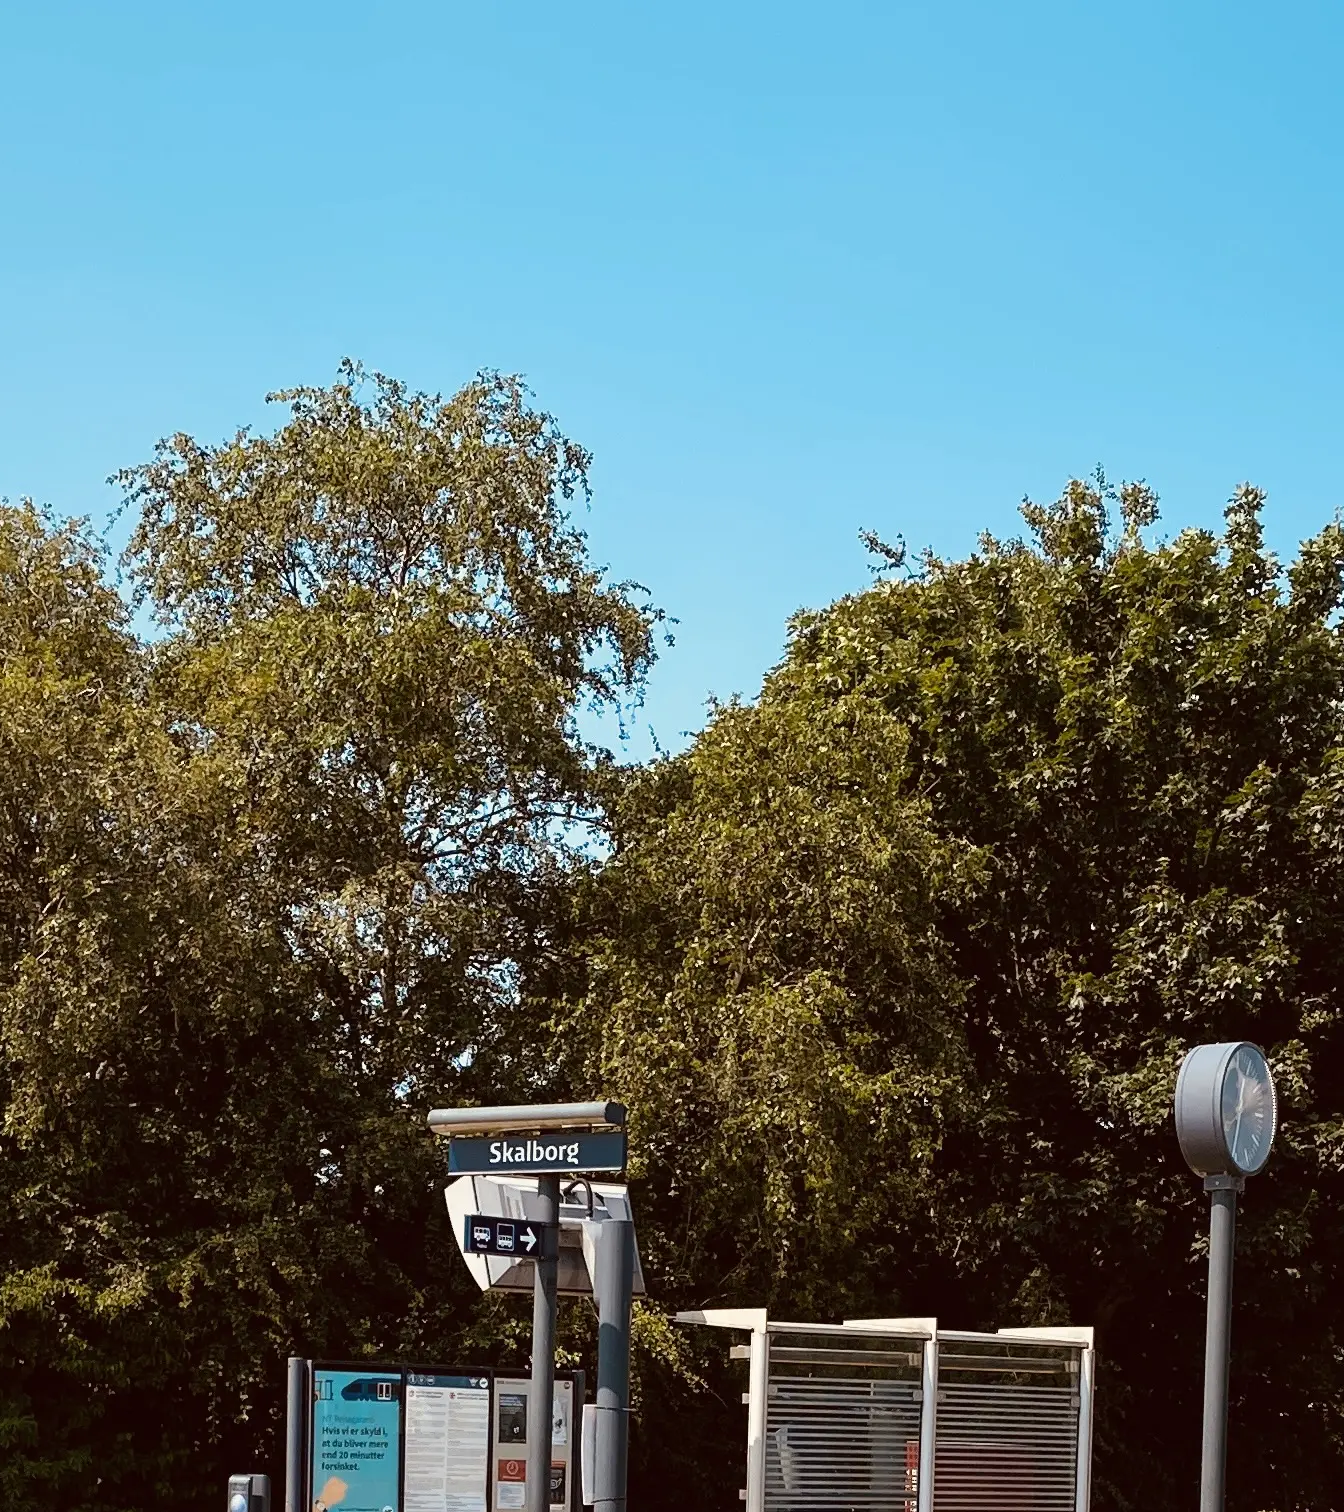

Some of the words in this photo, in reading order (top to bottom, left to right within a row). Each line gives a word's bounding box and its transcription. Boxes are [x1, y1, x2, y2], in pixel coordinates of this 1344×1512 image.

[489, 1141, 580, 1164] Skalborg
[322, 1427, 340, 1435] Hvis
[342, 1427, 349, 1435] vi
[332, 1439, 343, 1447] du
[344, 1439, 367, 1448] bliver
[350, 1451, 385, 1459] minutter
